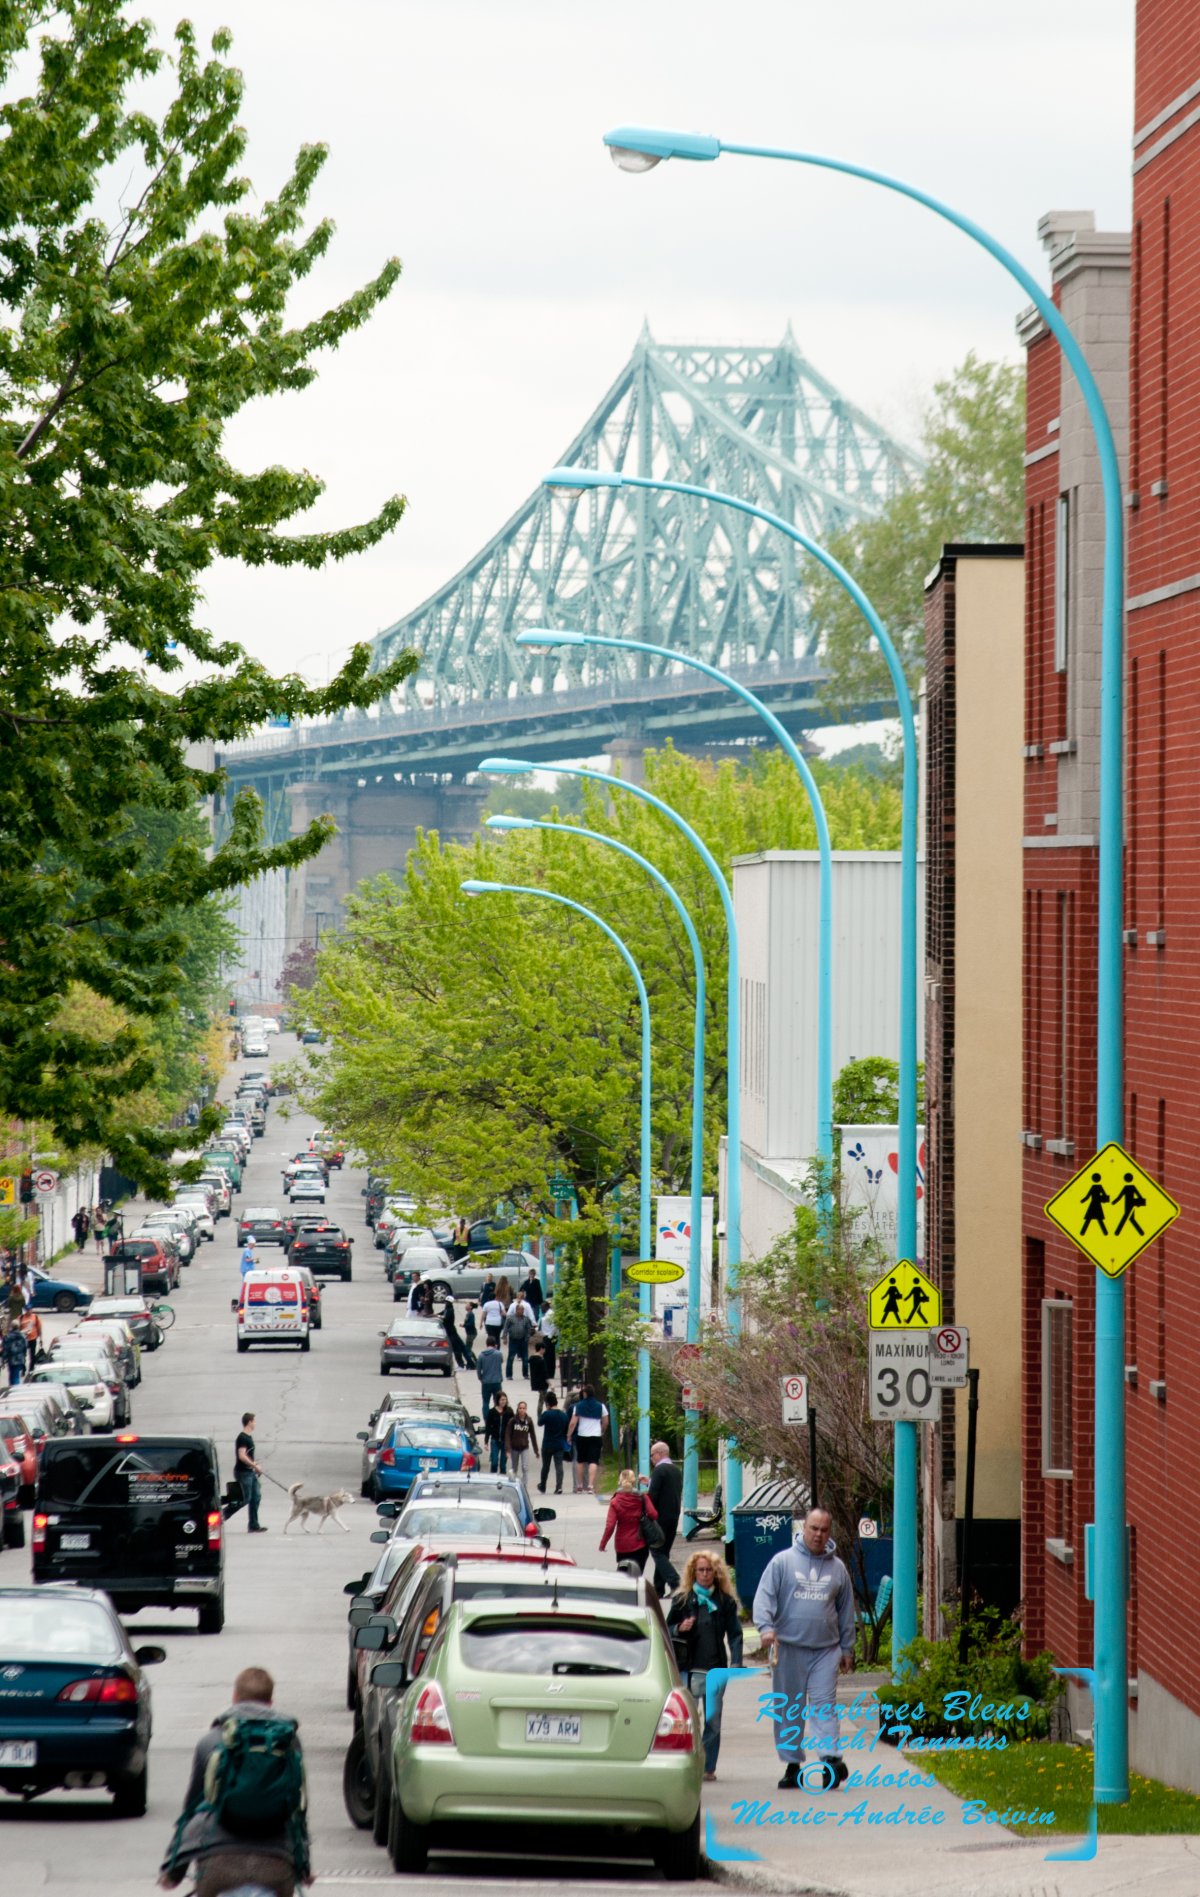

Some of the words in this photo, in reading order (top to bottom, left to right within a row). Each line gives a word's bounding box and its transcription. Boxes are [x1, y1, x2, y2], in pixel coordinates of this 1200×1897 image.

[631, 1268, 655, 1276] Corridor
[656, 1268, 680, 1276] scolaire
[876, 1367, 932, 1408] 30
[793, 1590, 830, 1601] adidas
[527, 1720, 550, 1736] X79
[557, 1720, 579, 1736] ARW
